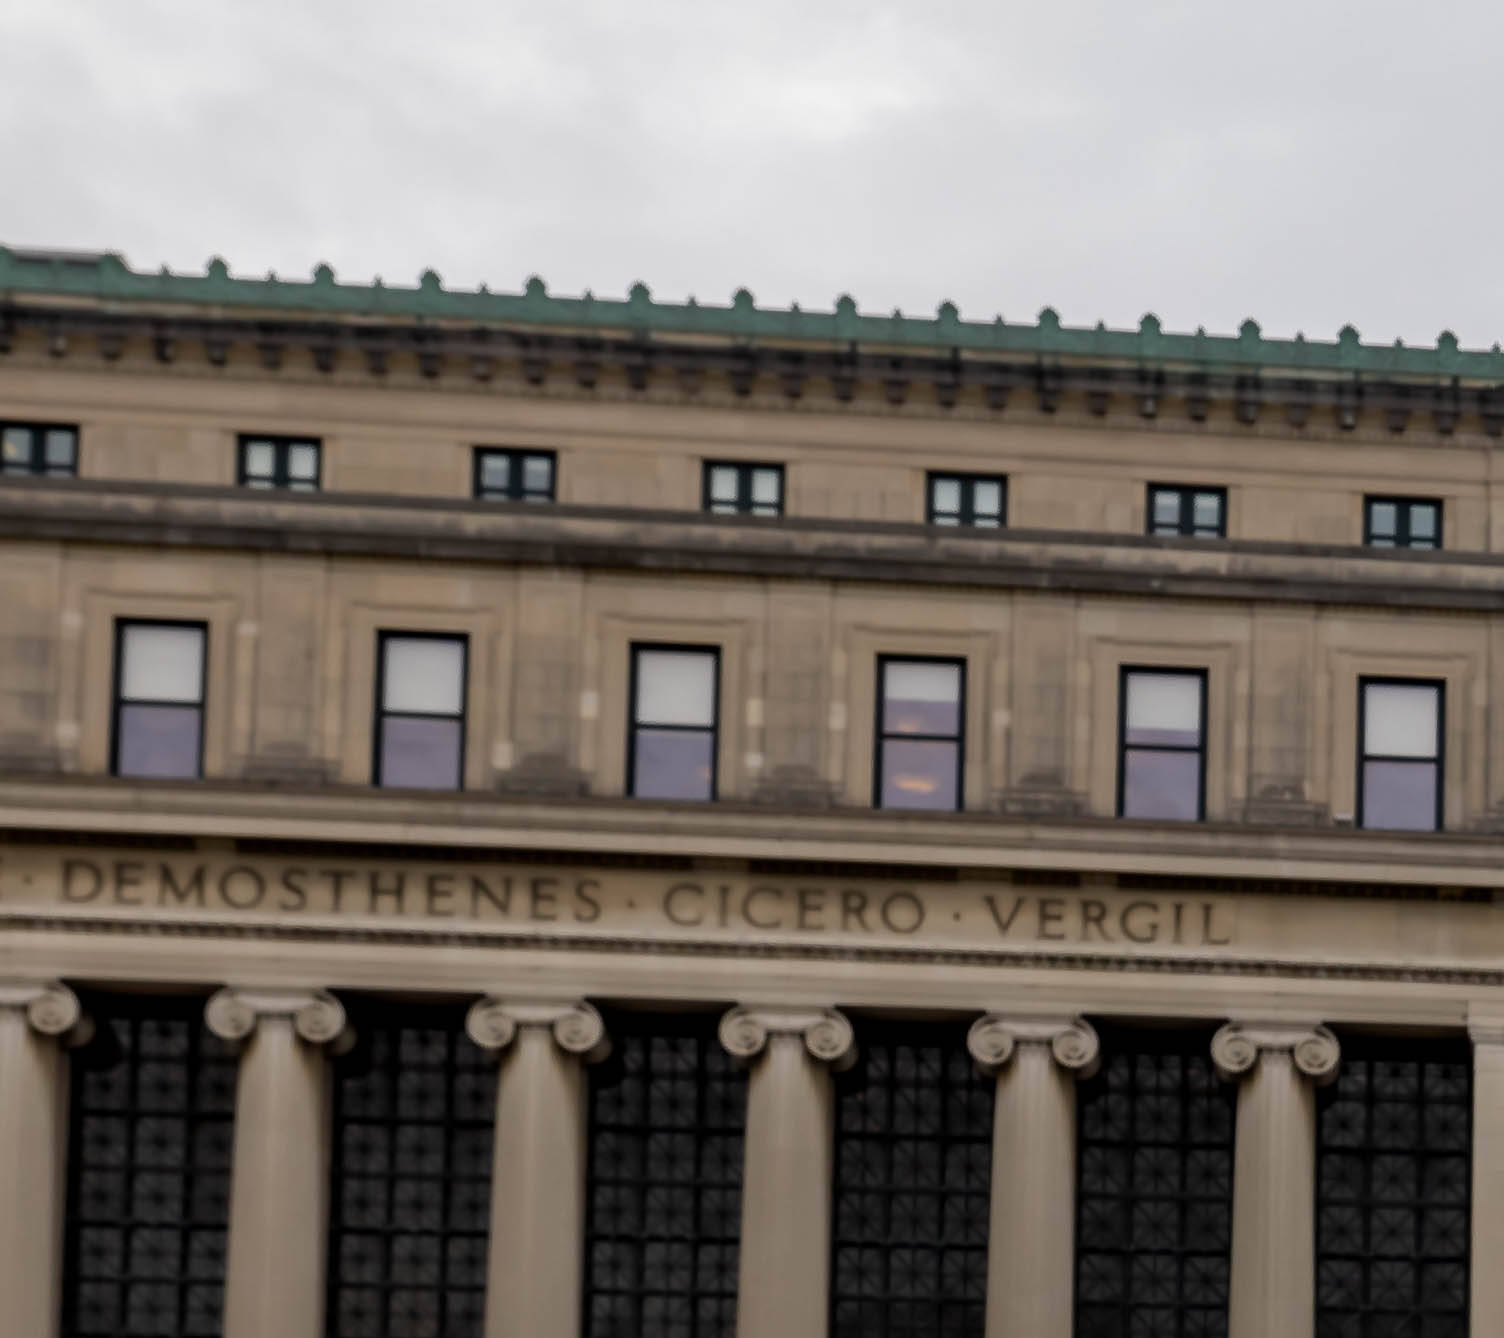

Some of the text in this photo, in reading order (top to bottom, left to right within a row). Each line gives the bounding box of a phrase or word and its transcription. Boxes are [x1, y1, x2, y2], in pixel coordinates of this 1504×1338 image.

[60, 858, 603, 924] DEMOSTHENES
[662, 882, 926, 935] CICERO
[983, 894, 1232, 946] VERGIL
